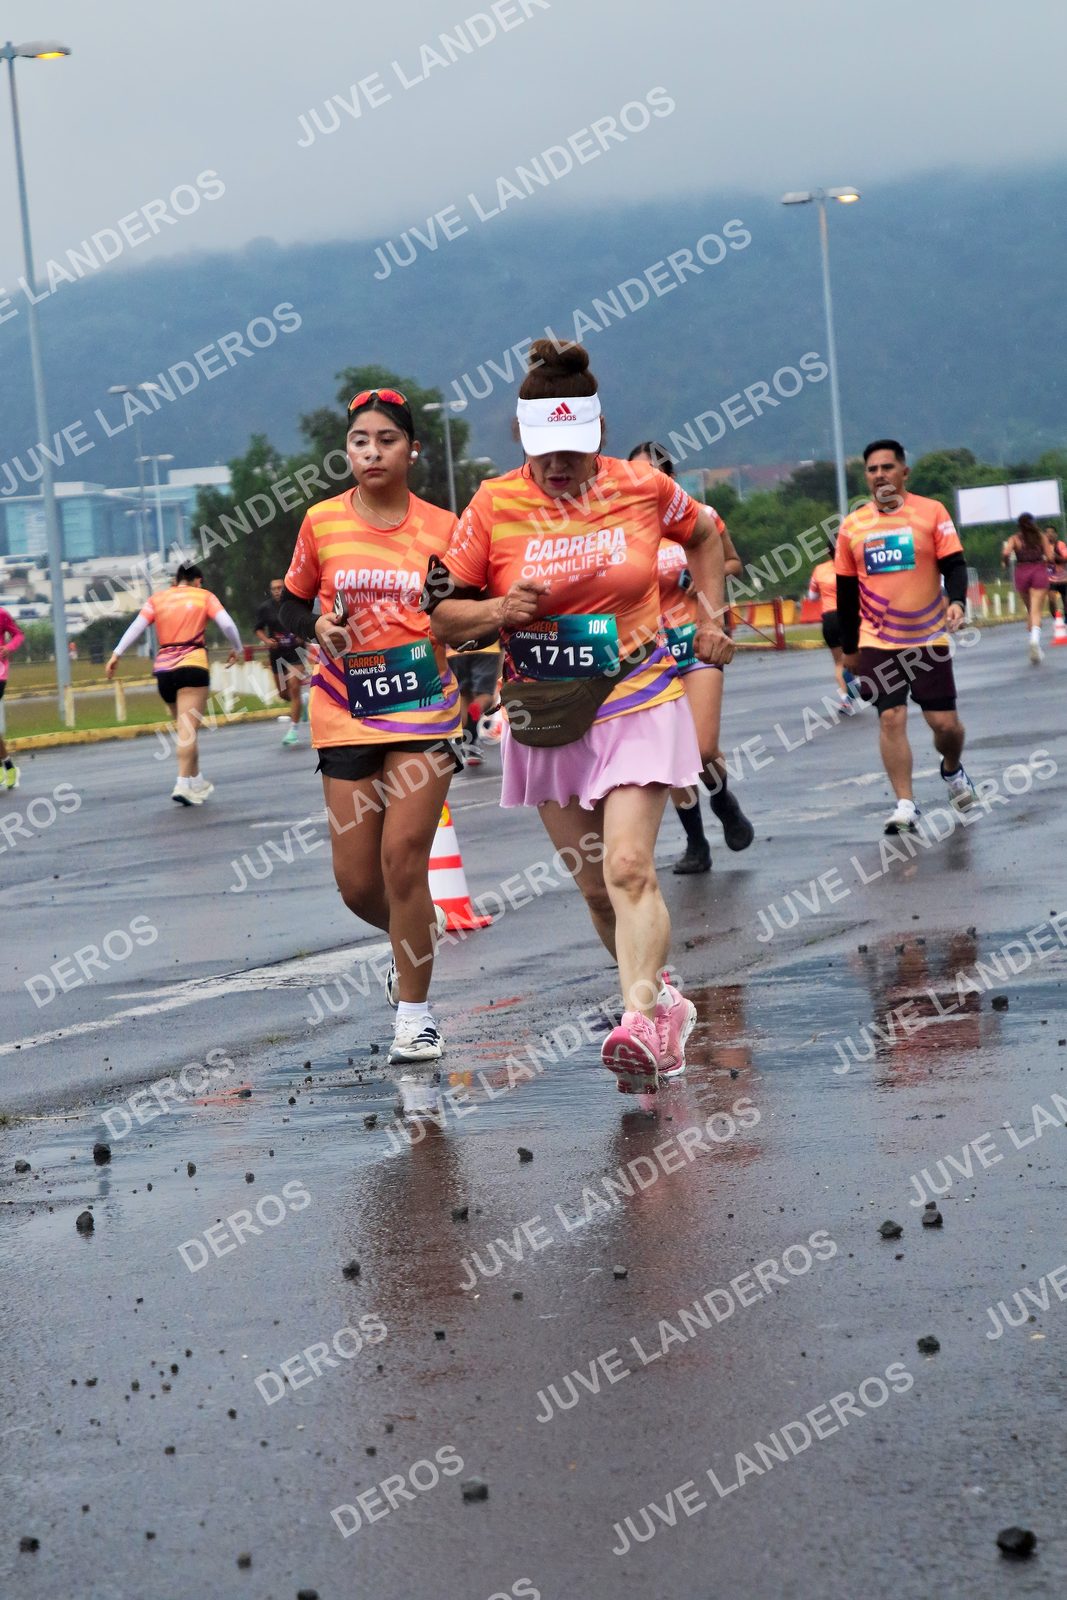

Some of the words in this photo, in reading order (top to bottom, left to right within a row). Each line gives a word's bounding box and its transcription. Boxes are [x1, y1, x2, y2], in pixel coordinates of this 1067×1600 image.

[548, 414, 576, 422] adidas
[525, 527, 626, 562] CARRERA
[871, 549, 903, 563] 1070
[521, 552, 605, 578] OMNILIFE
[334, 569, 421, 590] CARRERA
[588, 619, 608, 634] 10K
[410, 644, 427, 660] 10K
[530, 645, 594, 667] 1715
[666, 641, 687, 656] 67
[348, 654, 385, 668] CARRERA
[362, 671, 418, 697] 1613
